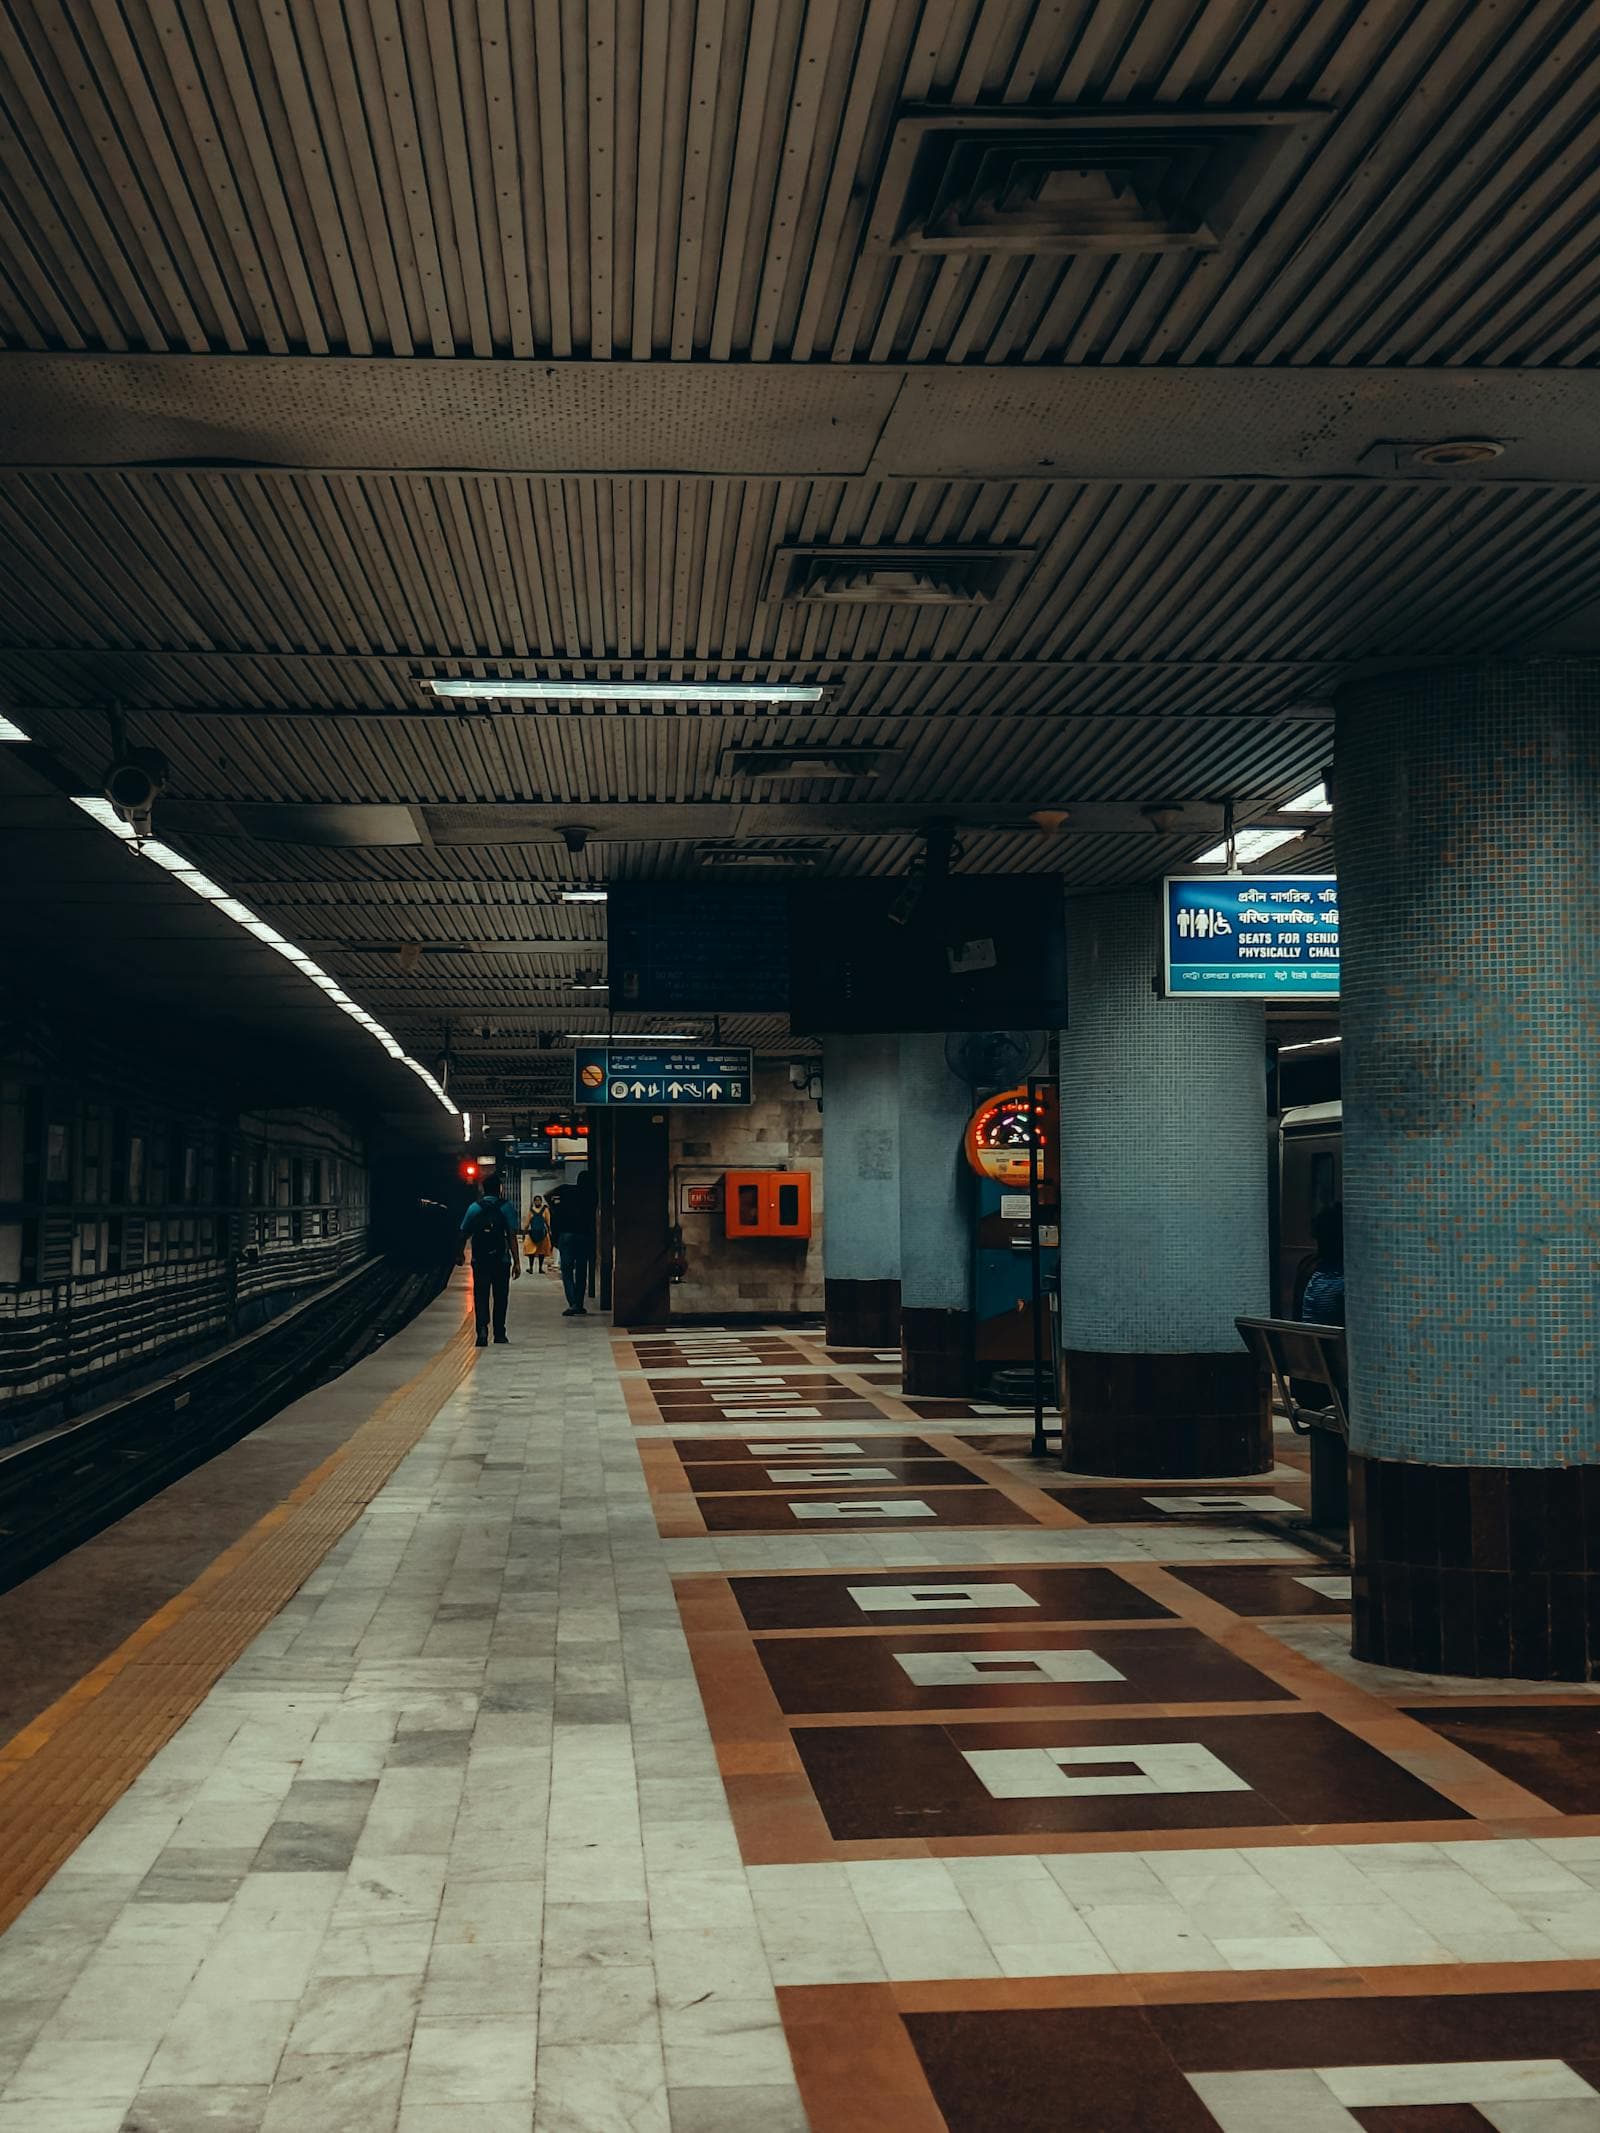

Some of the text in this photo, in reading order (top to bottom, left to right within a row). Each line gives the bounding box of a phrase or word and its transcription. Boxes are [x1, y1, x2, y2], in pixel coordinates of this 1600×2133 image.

[1269, 889, 1314, 904] নাগরিক,
[1238, 909, 1270, 924] वरिष्ठ
[1271, 909, 1318, 925] नागरिक,
[1238, 933, 1272, 944] SEATS
[1278, 933, 1300, 944] FOR
[1238, 947, 1301, 958] PHYSICALLY
